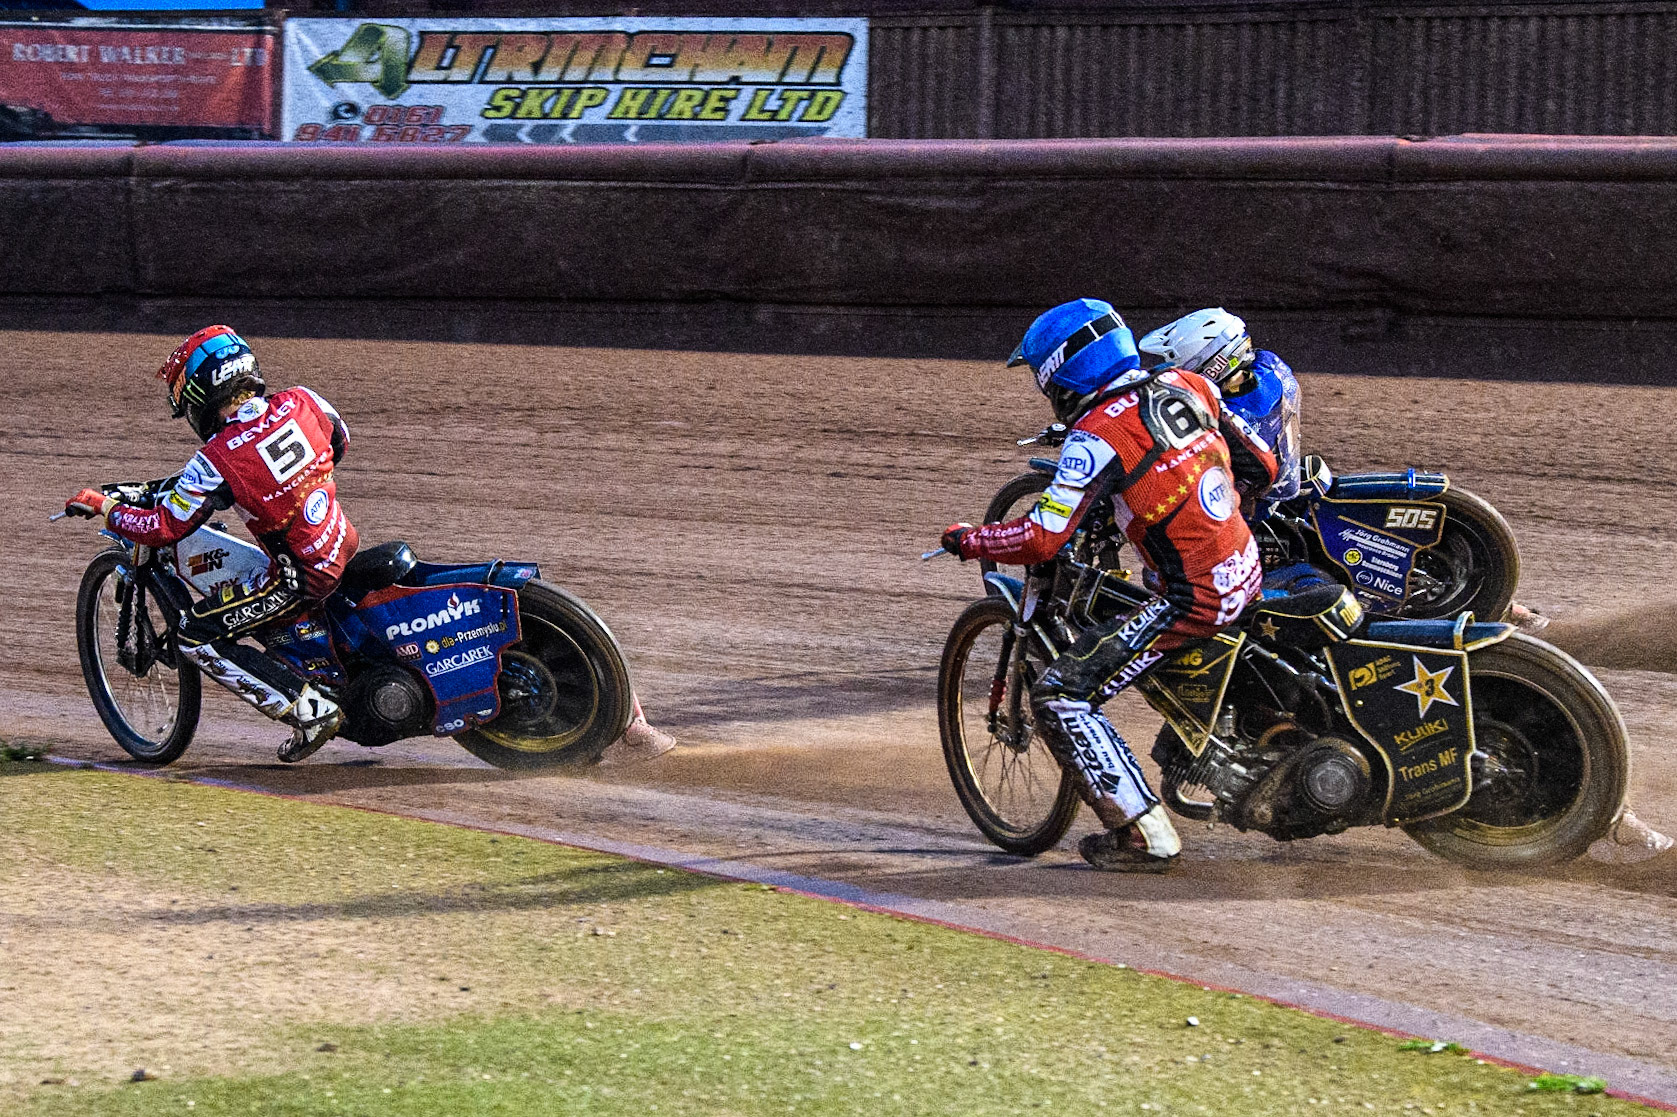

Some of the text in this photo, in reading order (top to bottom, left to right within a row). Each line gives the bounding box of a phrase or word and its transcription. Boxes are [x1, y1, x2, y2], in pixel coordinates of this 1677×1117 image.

[363, 104, 446, 125] 0161
[483, 87, 849, 122] SKIP HIRE LTD
[293, 123, 362, 142] 941
[1203, 354, 1230, 381] Bull
[226, 398, 296, 450] BEWLEY
[1160, 398, 1201, 439] 6
[265, 428, 306, 475] 5
[1374, 577, 1403, 595] Nice
[425, 644, 494, 675] GARCAREK
[1425, 678, 1435, 697] 3
[1398, 747, 1458, 782] Trans MF
